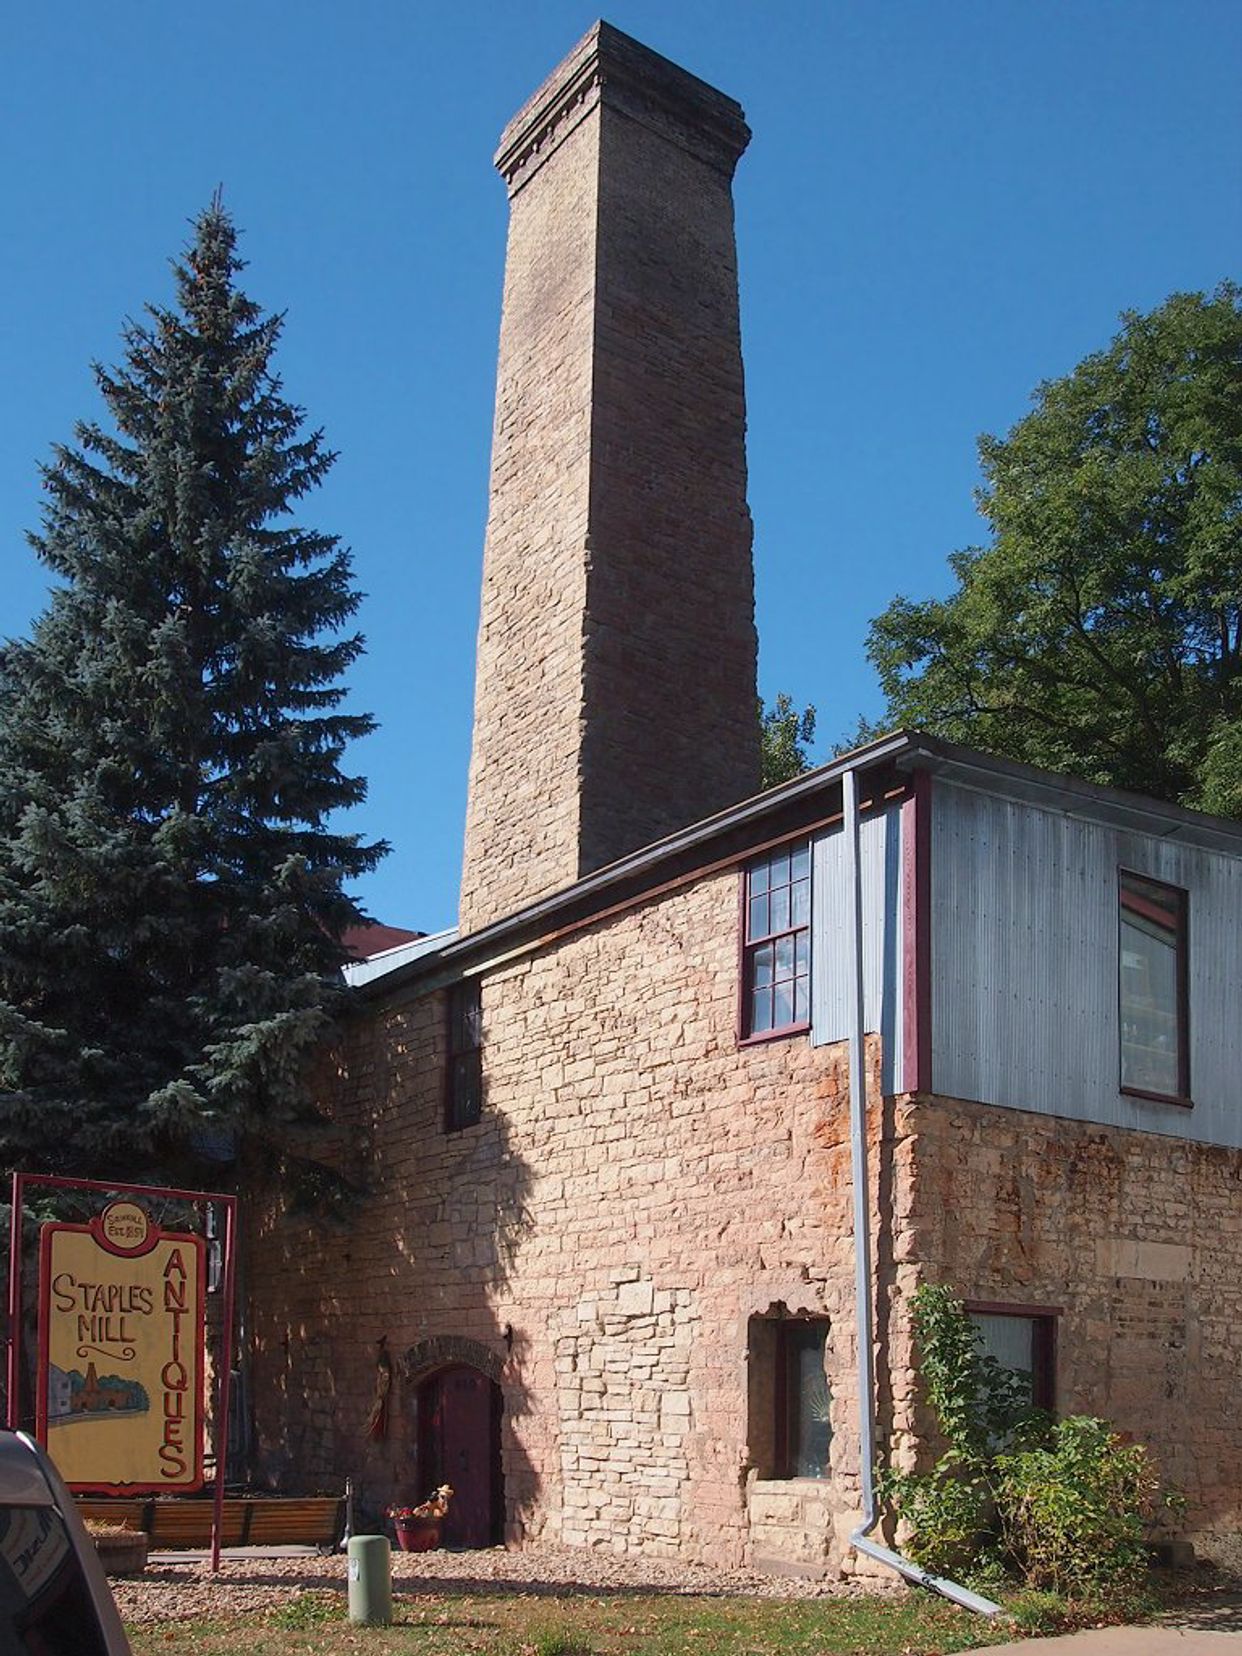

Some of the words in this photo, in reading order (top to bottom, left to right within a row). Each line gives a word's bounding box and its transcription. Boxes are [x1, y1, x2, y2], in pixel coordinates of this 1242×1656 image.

[52, 1272, 154, 1316] STAPLES
[77, 1314, 137, 1343] MILL
[158, 1248, 189, 1479] ANTIQUES
